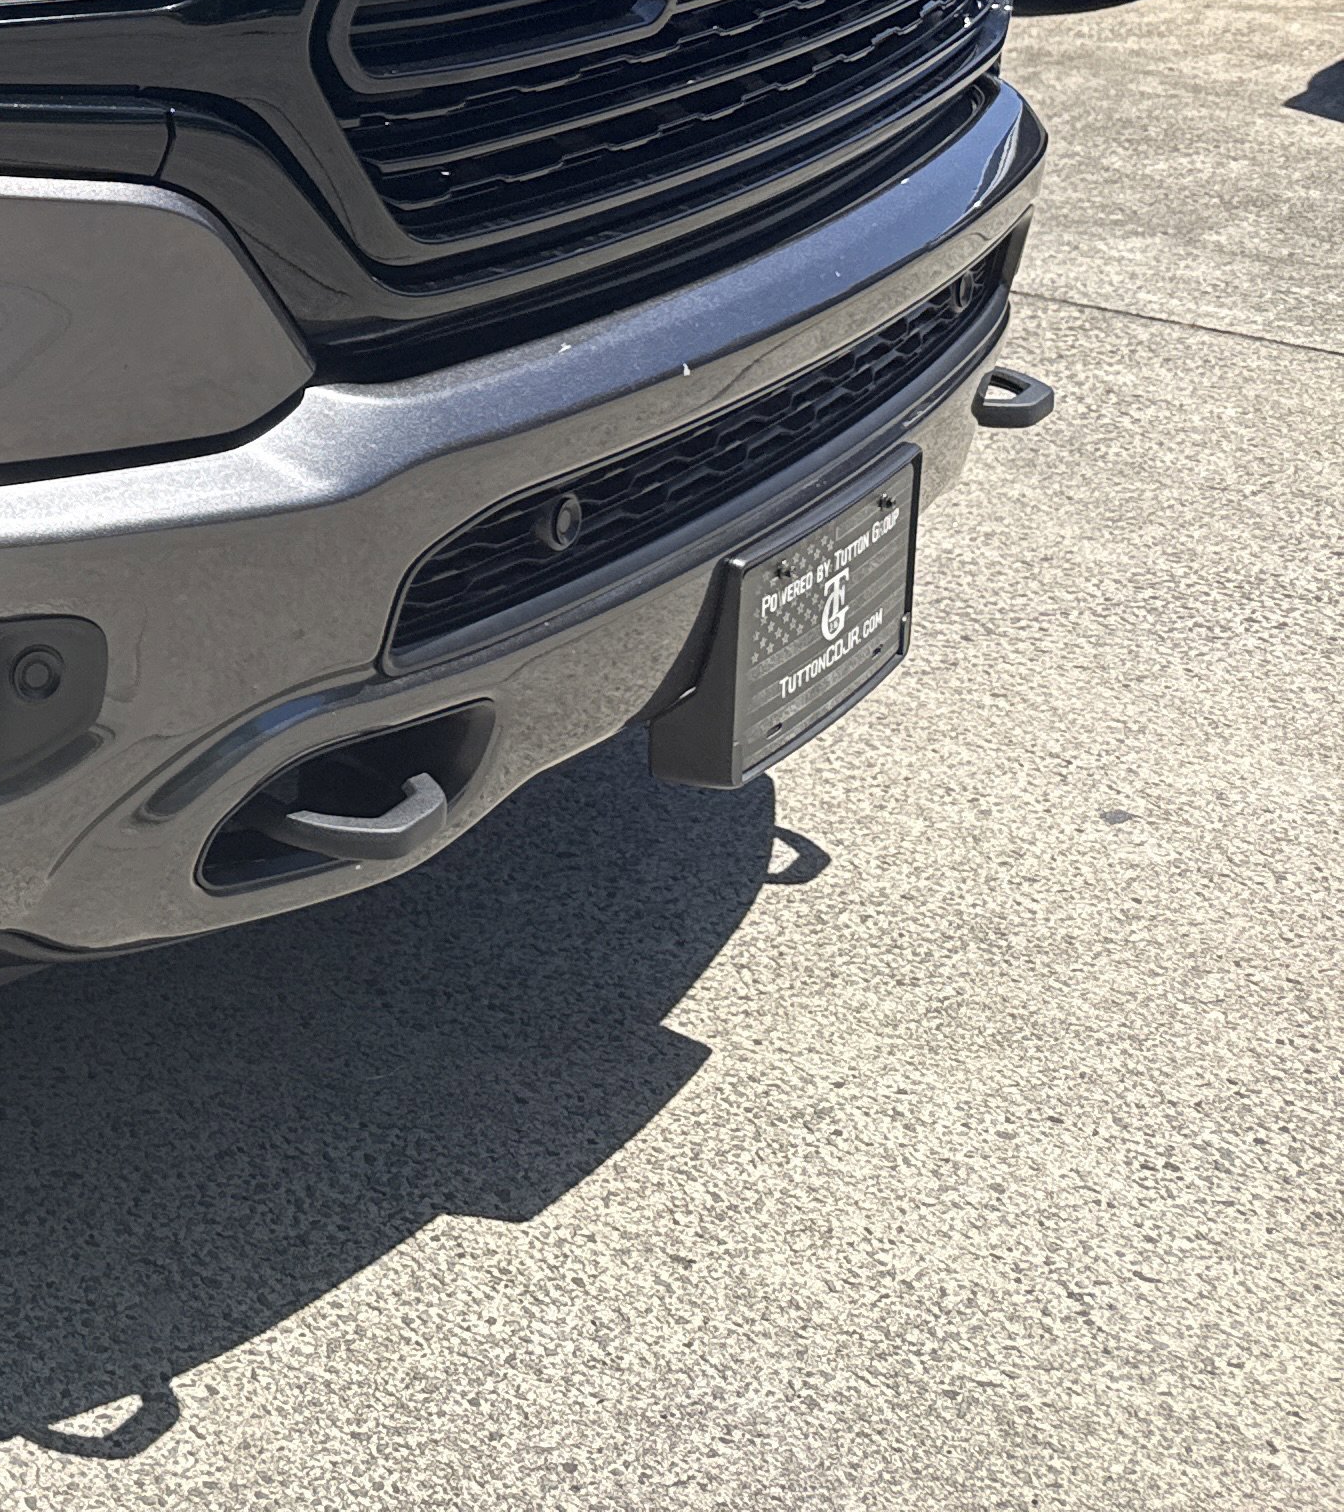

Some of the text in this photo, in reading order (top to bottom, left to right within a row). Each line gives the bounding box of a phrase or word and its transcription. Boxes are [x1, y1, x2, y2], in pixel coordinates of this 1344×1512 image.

[761, 570, 814, 618] POWERED
[816, 558, 831, 584] BY
[833, 530, 871, 572] TUTTON
